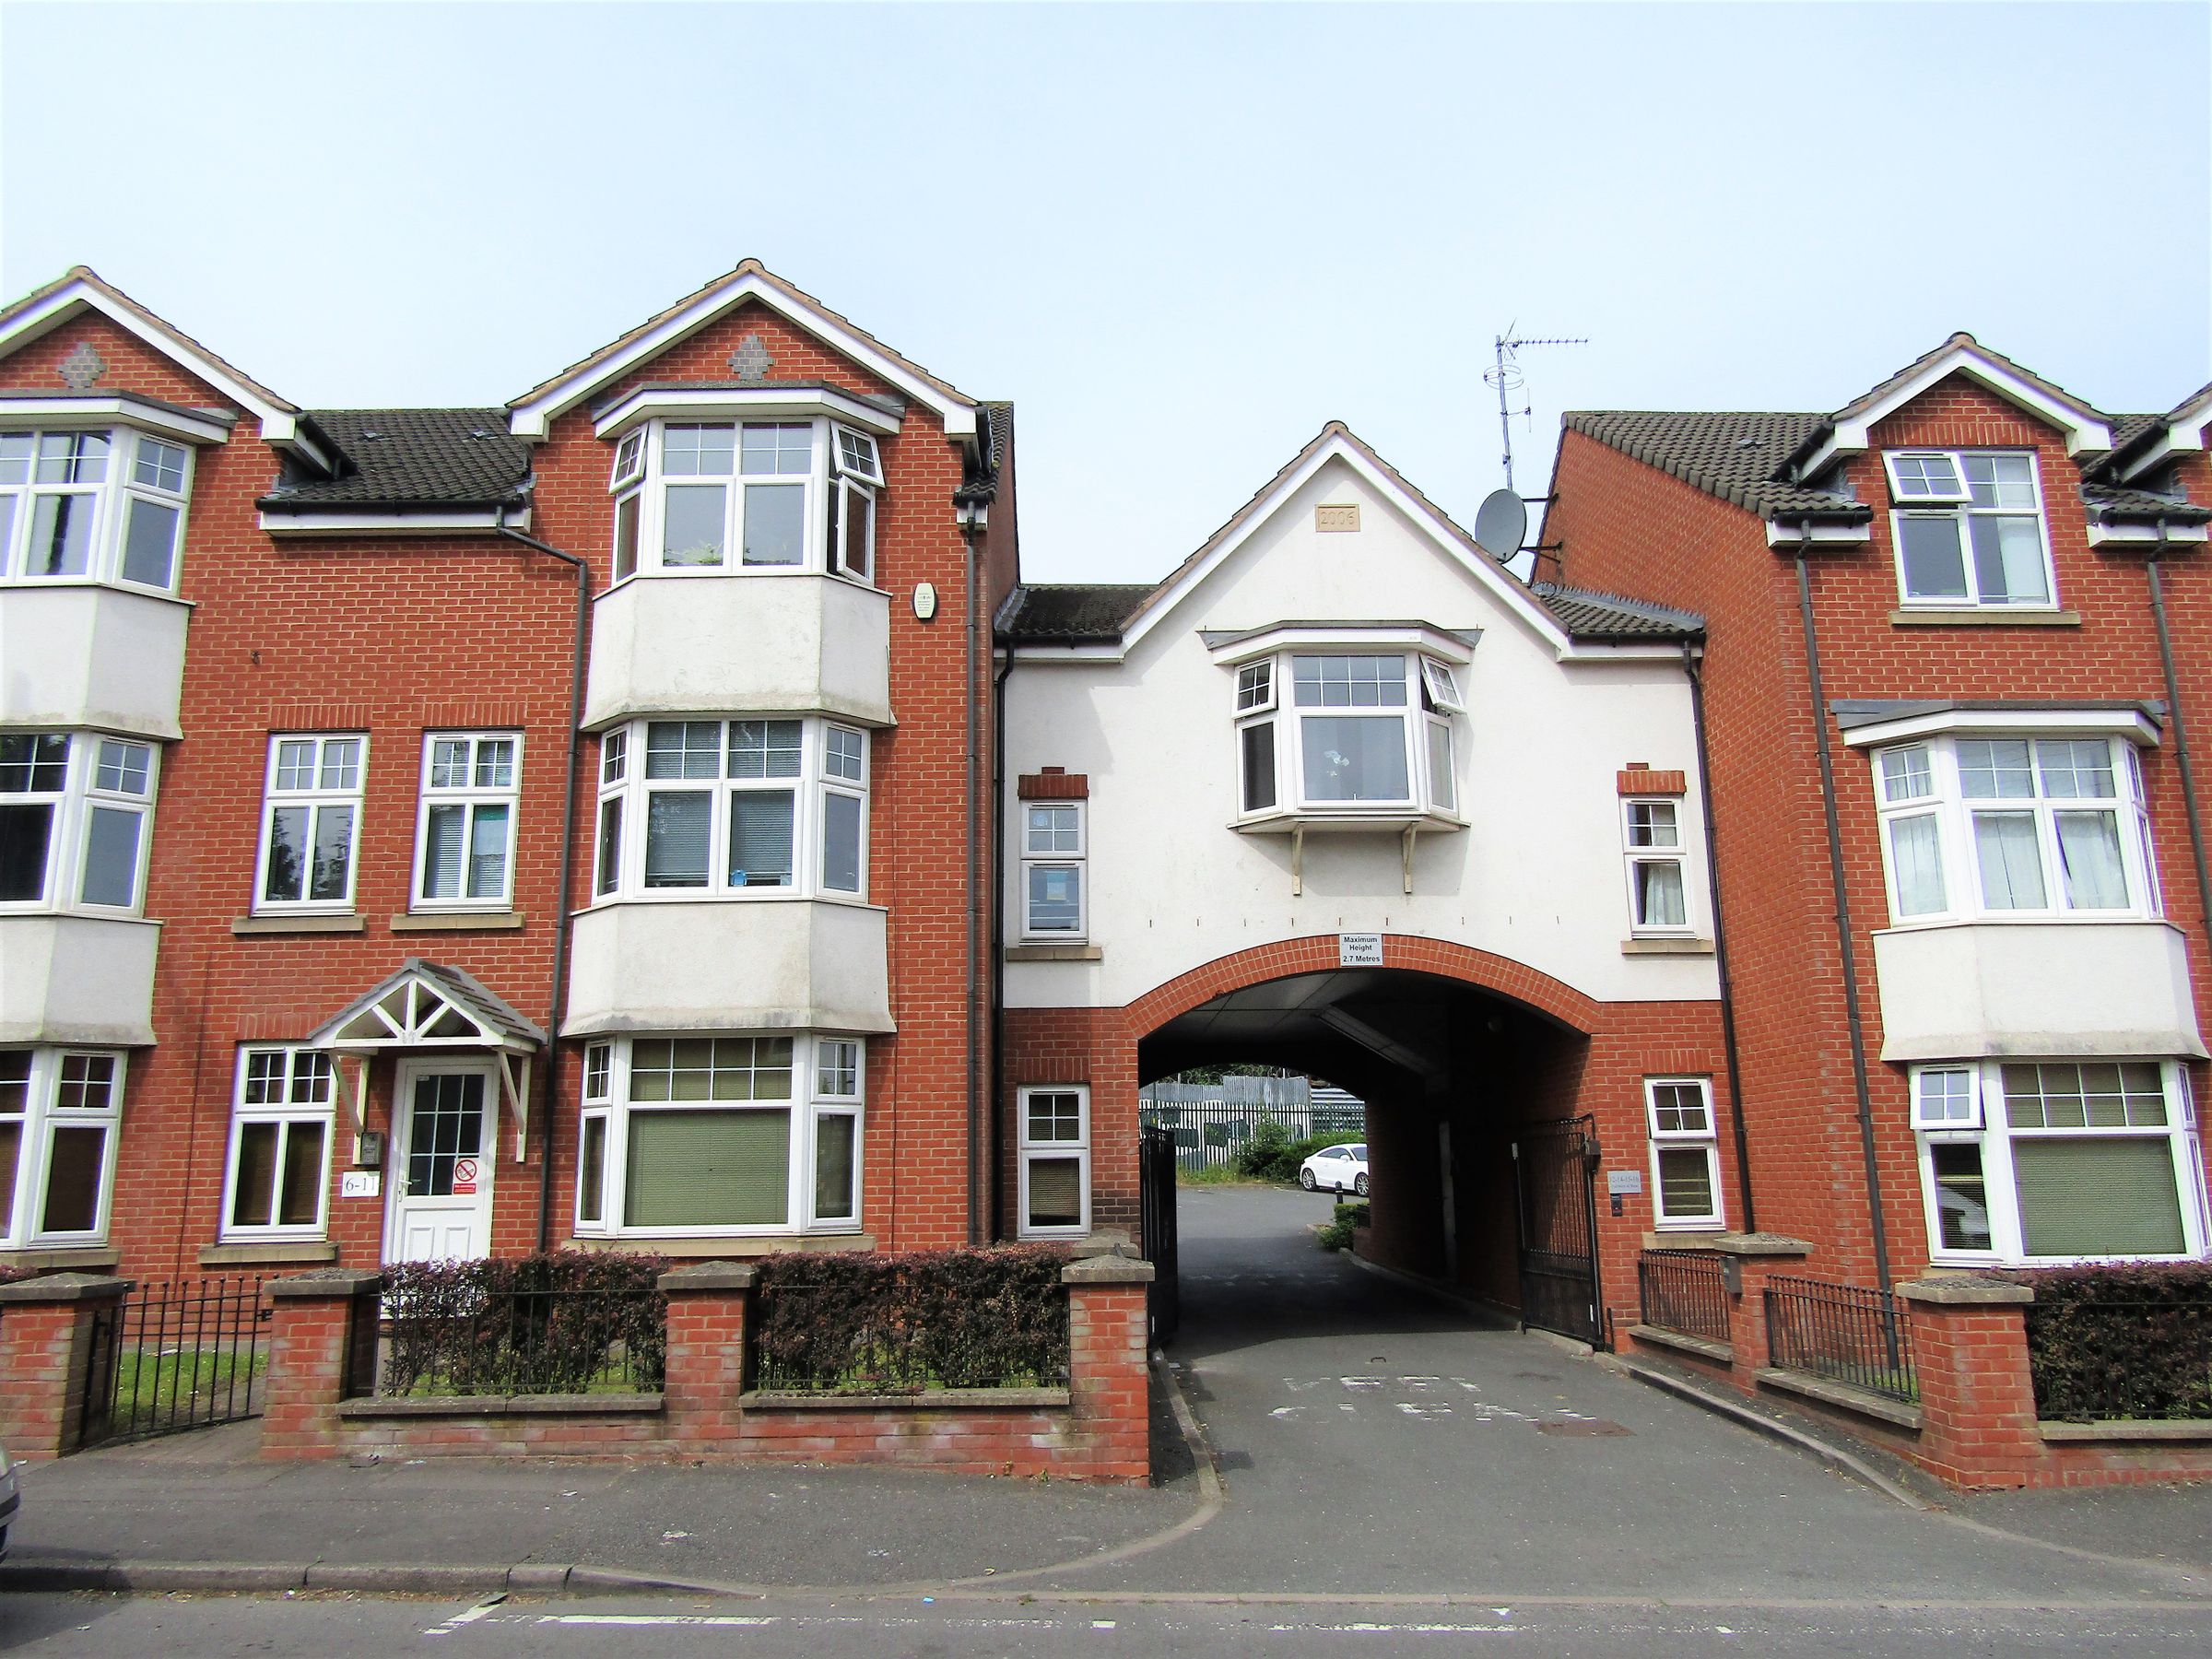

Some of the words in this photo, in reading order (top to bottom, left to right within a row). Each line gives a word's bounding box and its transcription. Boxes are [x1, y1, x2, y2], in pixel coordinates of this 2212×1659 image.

[1320, 511, 1355, 525] 2006
[1349, 944, 1372, 952] Height
[346, 1177, 375, 1192] 6-11
